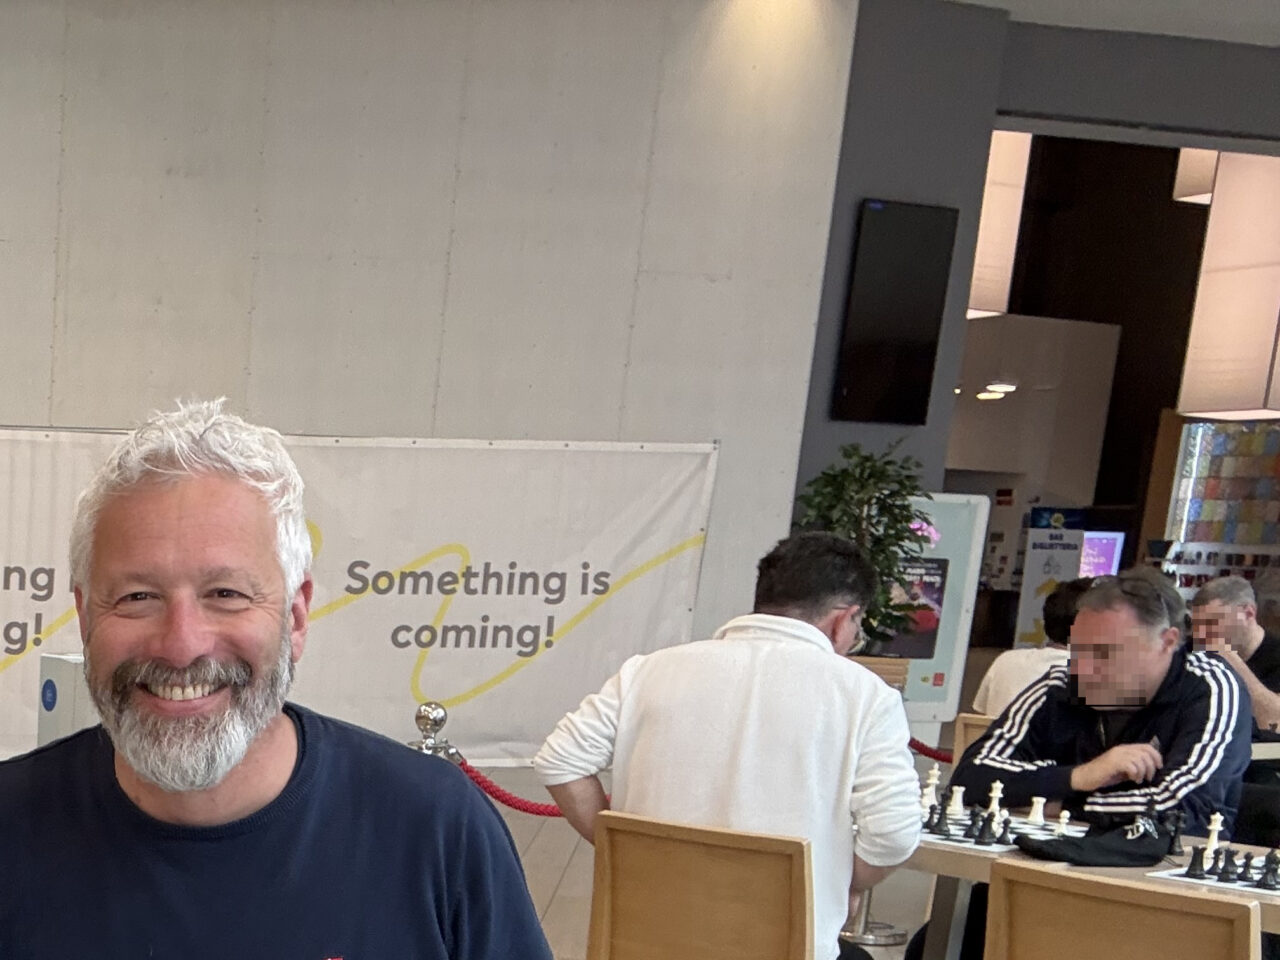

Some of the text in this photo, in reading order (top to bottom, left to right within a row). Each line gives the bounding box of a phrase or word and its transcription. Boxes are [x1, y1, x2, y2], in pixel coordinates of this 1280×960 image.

[344, 560, 611, 605] Something is
[390, 614, 555, 658] coming!
